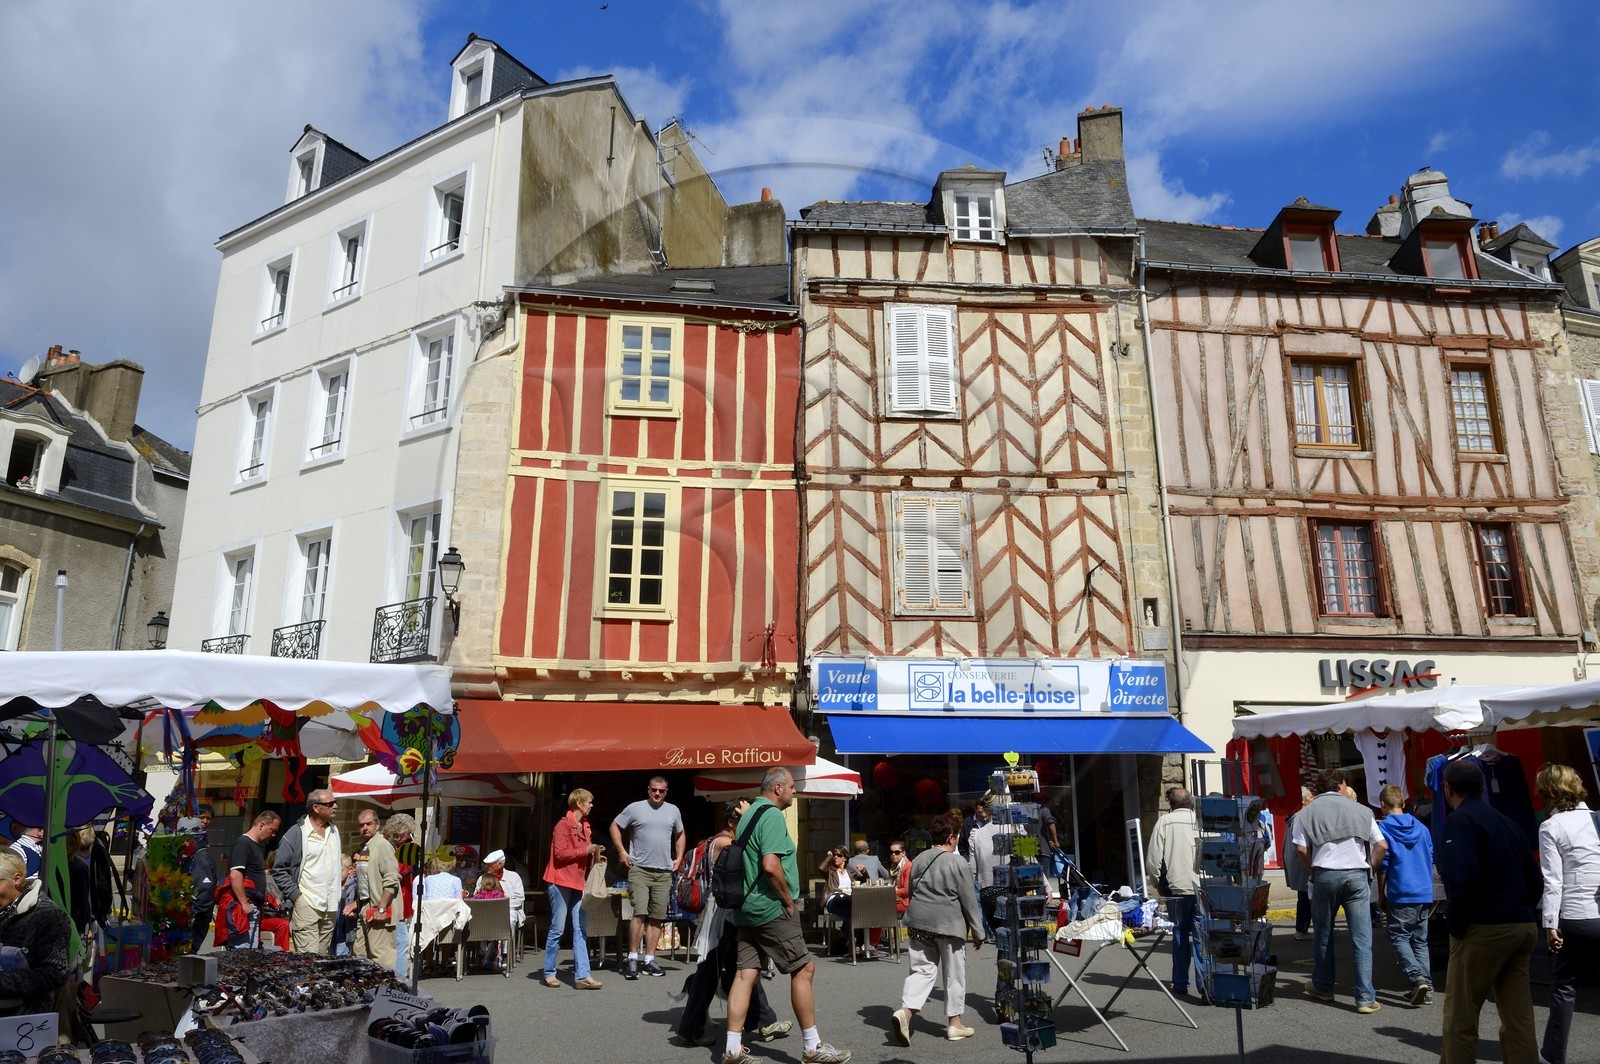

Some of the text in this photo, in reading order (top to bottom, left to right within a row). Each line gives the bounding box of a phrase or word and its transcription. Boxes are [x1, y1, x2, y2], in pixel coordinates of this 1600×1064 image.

[827, 669, 871, 684] Vente
[948, 671, 1018, 681] CONSERVERIE
[1117, 672, 1159, 687] Vente
[1318, 659, 1438, 688] LISSAC
[821, 686, 876, 703] directe
[948, 683, 1076, 704] la belle-iloise
[1113, 688, 1166, 705] directe
[659, 746, 782, 767] Bar Le Raffiau
[17, 1020, 52, 1051] 8€
